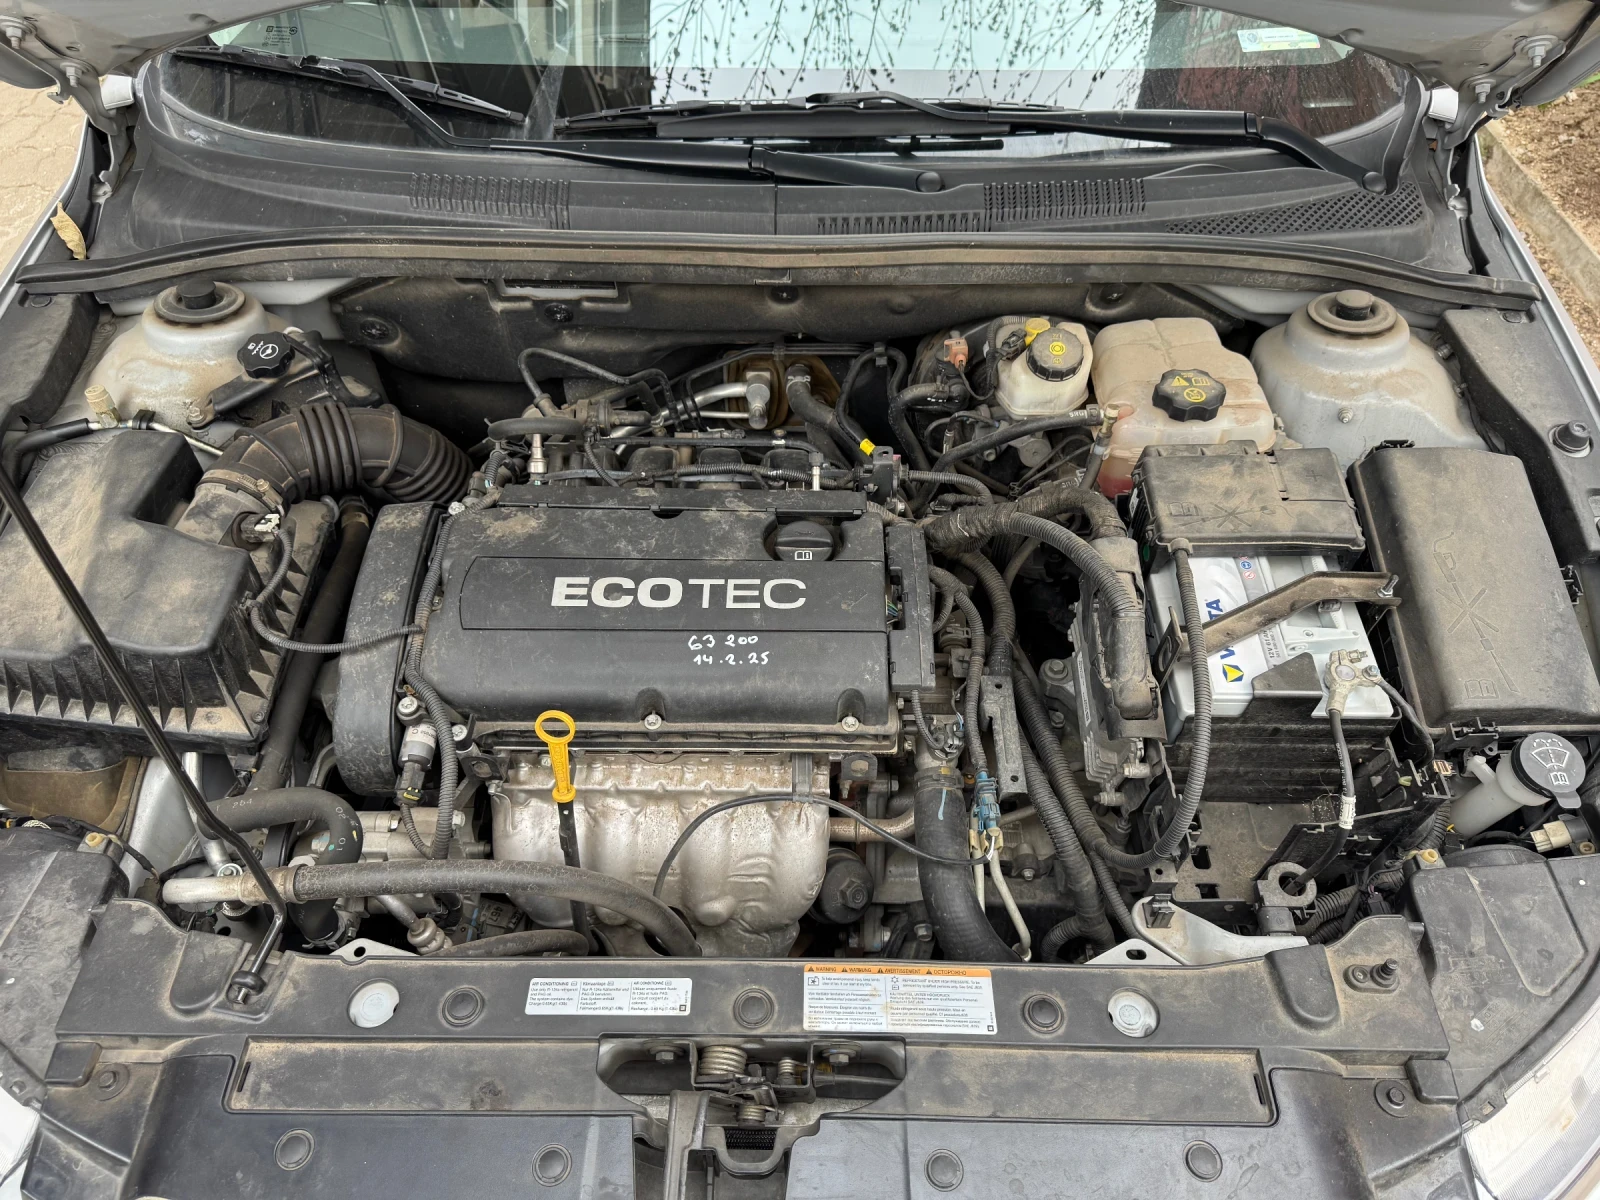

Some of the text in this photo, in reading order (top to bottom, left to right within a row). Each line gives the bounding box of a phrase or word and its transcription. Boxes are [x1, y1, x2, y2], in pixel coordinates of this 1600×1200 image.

[551, 577, 807, 609] ECOTEC
[688, 634, 758, 651] 63 200
